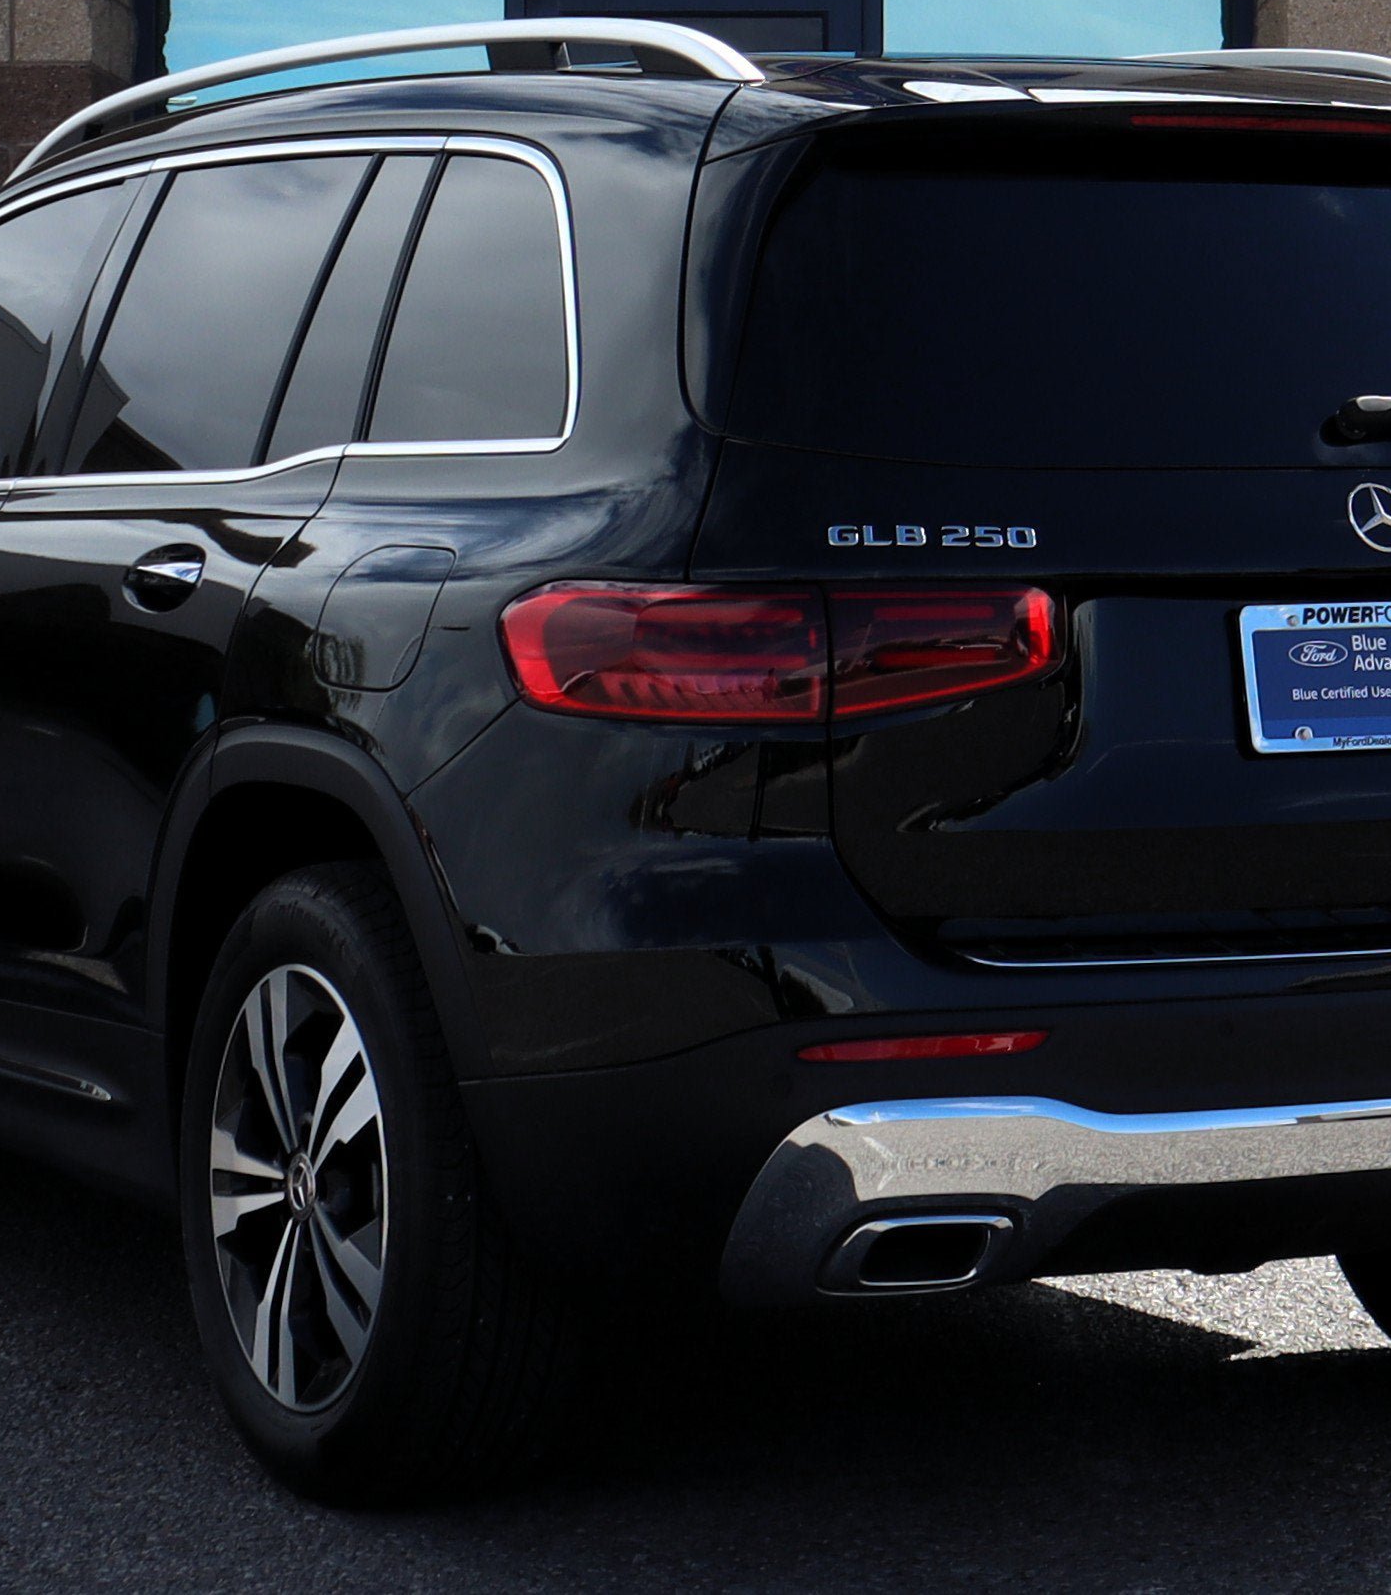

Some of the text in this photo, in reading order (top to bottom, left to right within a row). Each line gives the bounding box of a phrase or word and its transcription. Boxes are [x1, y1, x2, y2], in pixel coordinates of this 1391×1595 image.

[827, 525, 1037, 548] GLB 250
[1351, 635, 1387, 651] Blue
[1300, 644, 1337, 662] Ford
[1292, 688, 1318, 701] Blue
[1321, 686, 1368, 700] Certified
